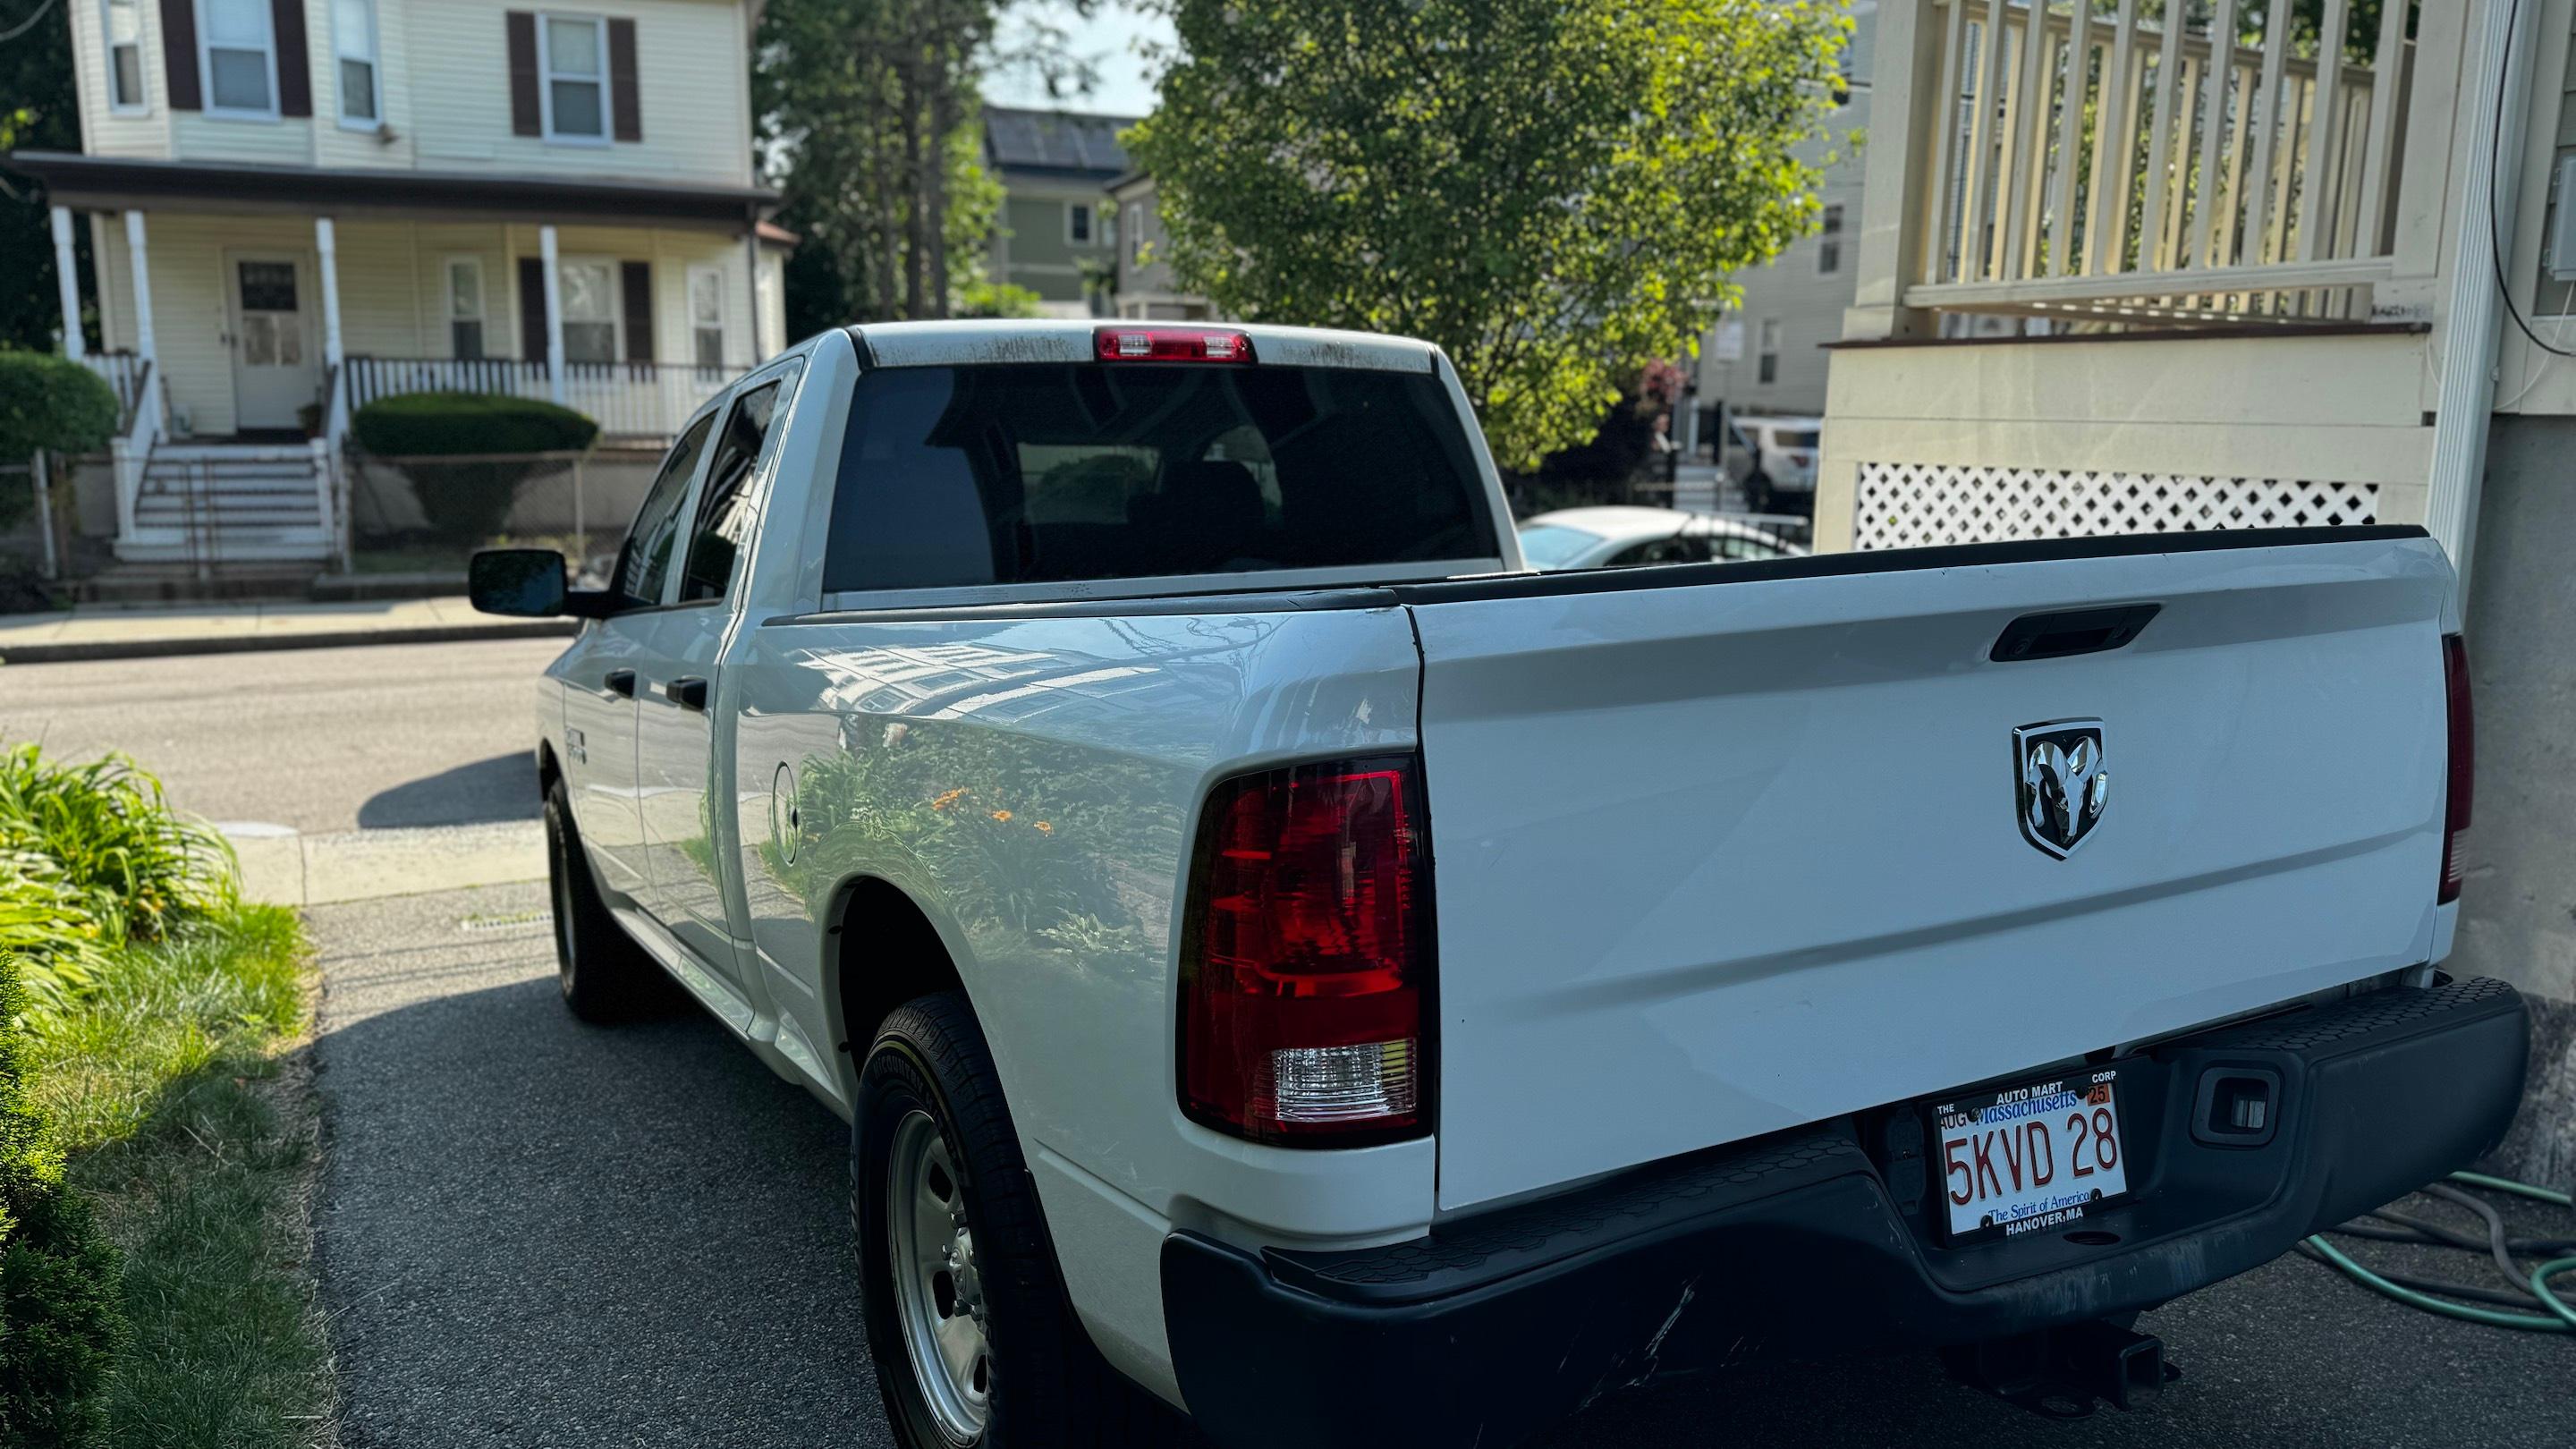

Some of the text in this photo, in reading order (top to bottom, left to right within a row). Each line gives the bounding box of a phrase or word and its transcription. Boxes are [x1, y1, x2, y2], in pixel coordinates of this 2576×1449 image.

[1936, 1070, 2116, 1115] THE AUTO MART CORP
[2089, 1085, 2106, 1104] 25
[1945, 1107, 2118, 1206] 5KVD 28
[1988, 1191, 2090, 1222] The Spirit of America
